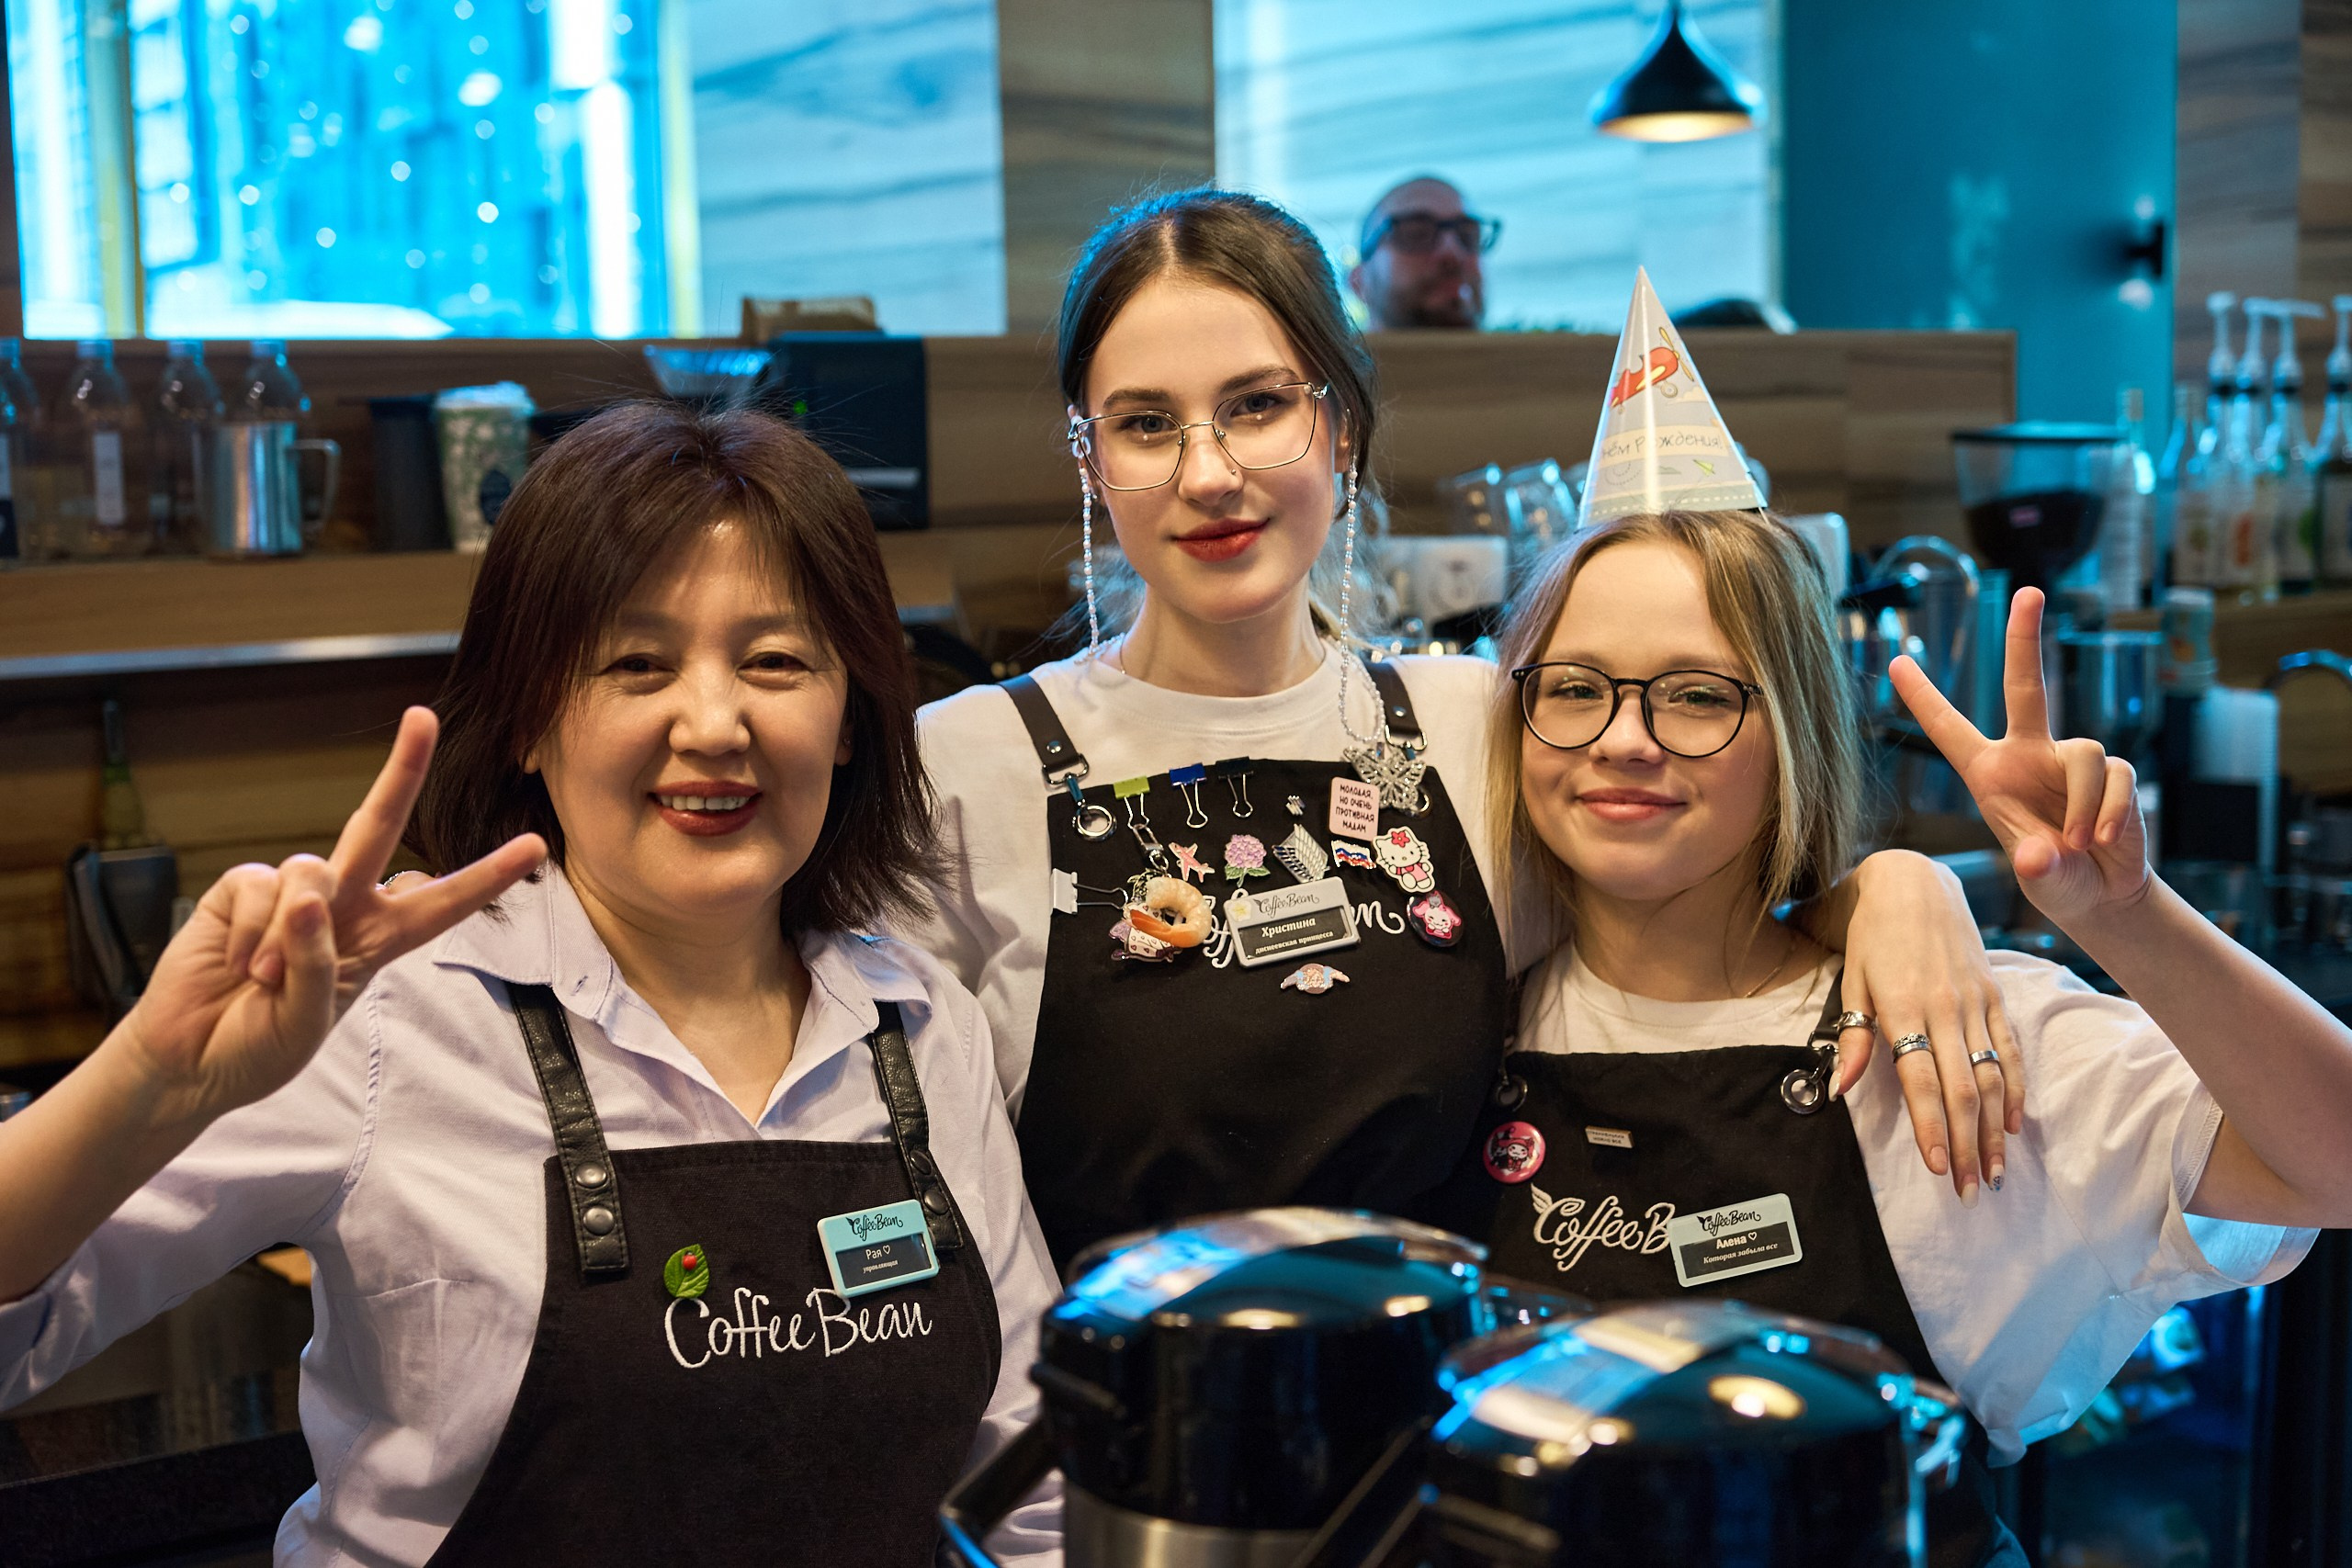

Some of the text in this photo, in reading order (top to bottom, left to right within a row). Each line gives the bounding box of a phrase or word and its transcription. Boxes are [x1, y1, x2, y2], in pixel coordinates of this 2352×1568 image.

[1602, 432, 1724, 458] нём Рждения!
[1340, 795, 1372, 810] НО ОЧЕНЬ
[1335, 807, 1374, 823] ПРОТИВНАЯ
[1342, 820, 1366, 832] МАДАМ
[1259, 893, 1319, 919] Coffee Bean
[1261, 918, 1316, 938] Христина
[1255, 931, 1334, 954] диснеевская принцесса
[852, 1213, 904, 1242] Coffee Bean
[1533, 1195, 1644, 1271] Coffee
[1702, 1210, 1761, 1236] Coffee Bean
[1702, 1242, 1779, 1264] Которая забыла все
[1716, 1235, 1747, 1249] Алена
[865, 1248, 882, 1260] Рая
[664, 1287, 933, 1369] Coffee Bean
